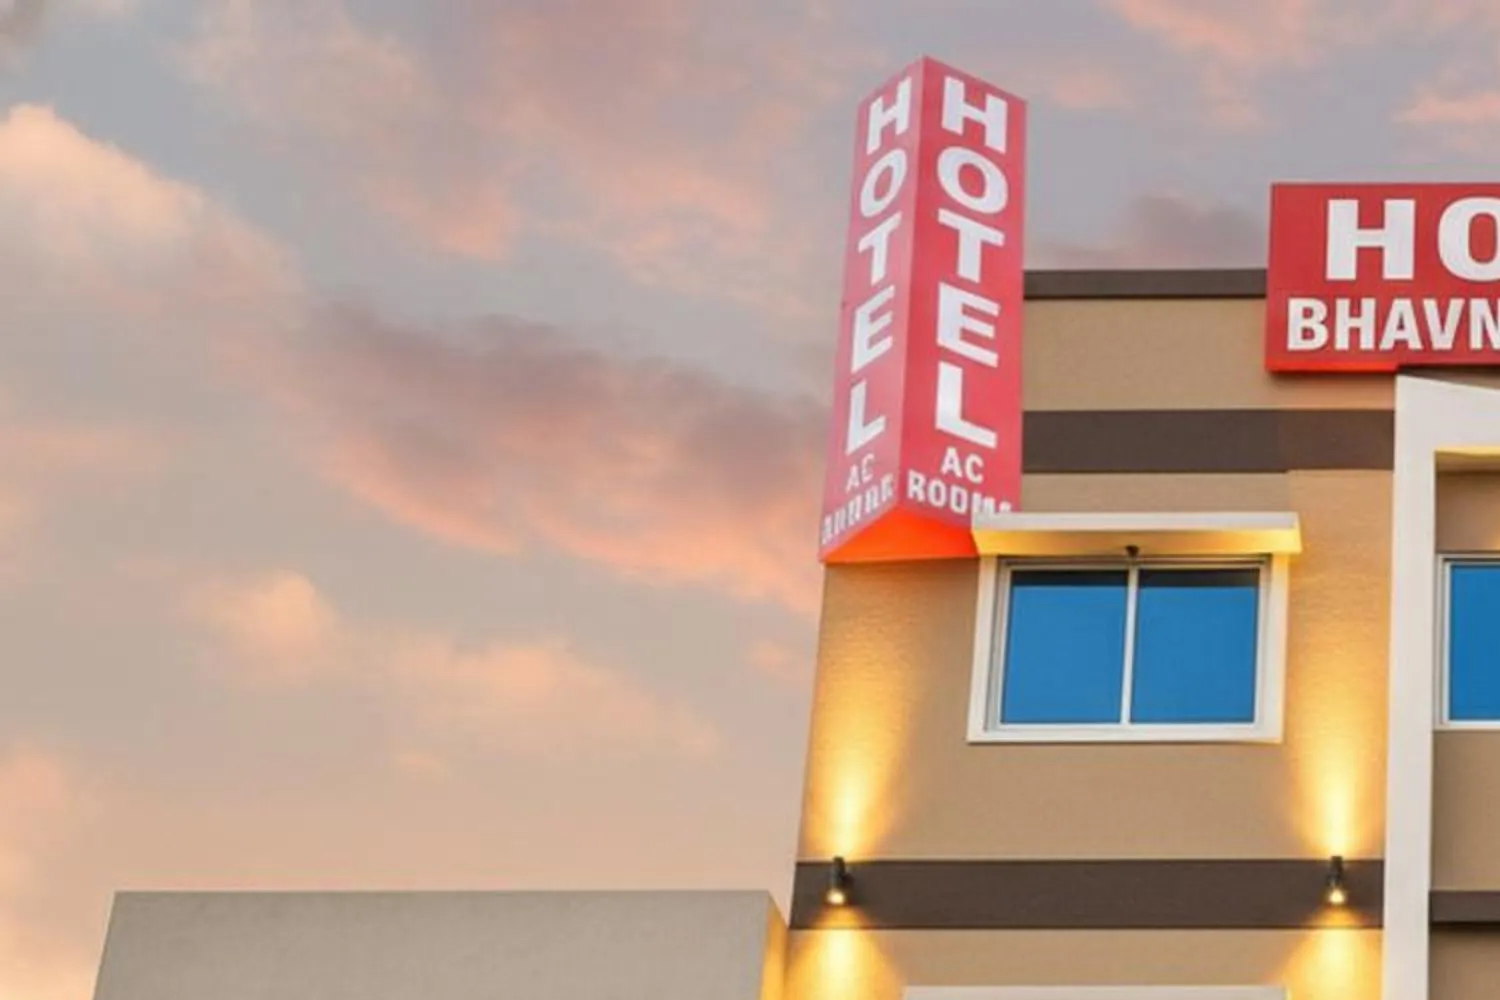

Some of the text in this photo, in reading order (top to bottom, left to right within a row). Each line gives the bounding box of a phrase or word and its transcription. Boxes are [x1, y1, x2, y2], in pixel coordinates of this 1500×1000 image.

[846, 77, 912, 456] HOTEL
[935, 76, 1010, 450] HOTEL
[942, 447, 984, 484] AC
